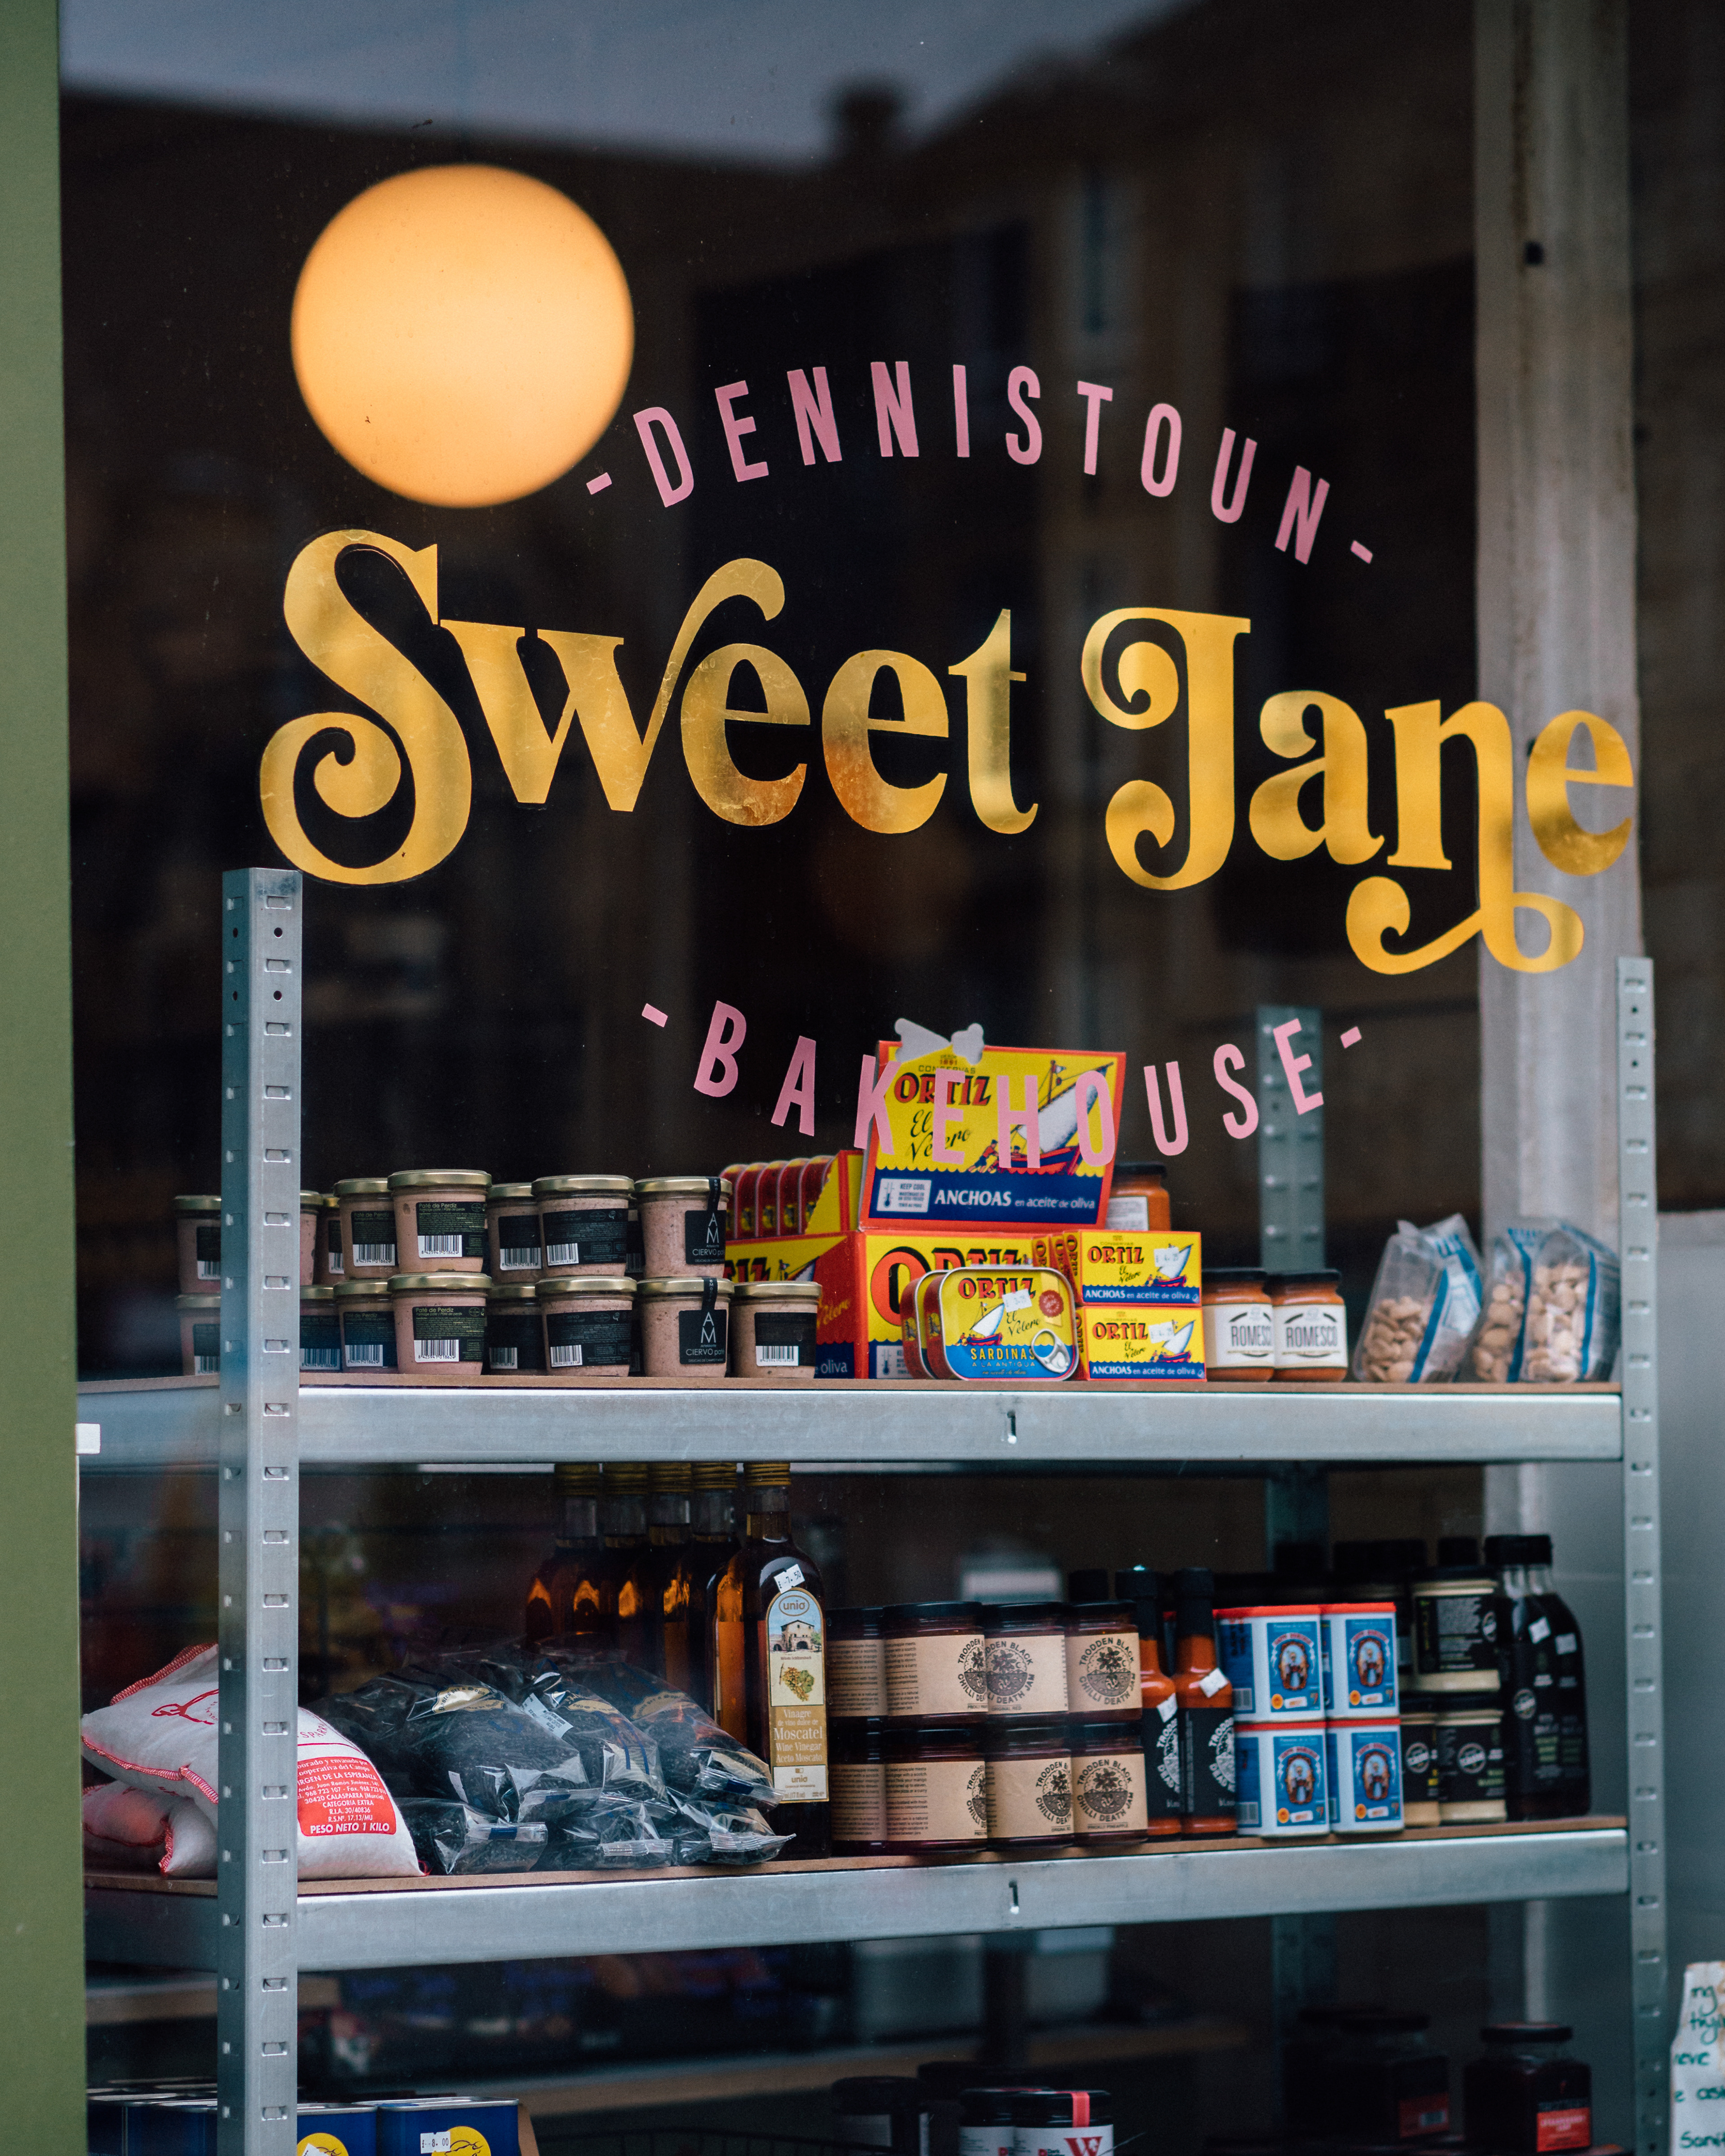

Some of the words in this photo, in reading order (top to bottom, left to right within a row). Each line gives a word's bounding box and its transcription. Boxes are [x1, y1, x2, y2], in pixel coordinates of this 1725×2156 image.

[259, 528, 1039, 885] Sweet
[1082, 606, 1634, 973] Jane
[934, 1190, 1011, 1206] ANCHOAS
[1026, 1197, 1057, 1208] aceite
[1058, 1200, 1069, 1208] de
[1070, 1197, 1095, 1209] oliva
[1087, 1246, 1145, 1264] ORTIZ
[958, 1277, 1036, 1299] ORTIZ
[1085, 1290, 1125, 1299] ANCHOAS
[1092, 1322, 1149, 1340] ORTIZ
[1231, 1325, 1272, 1347] ROMESC
[1286, 1325, 1338, 1348] ROMESCO
[970, 1348, 1035, 1360] SARDINAS
[820, 1359, 848, 1374] oliva
[1092, 1366, 1132, 1374] ANCHOAS
[1010, 1642, 1034, 1666] BLACK
[1079, 1637, 1114, 1666] TRODDEN
[1116, 1639, 1134, 1662] BLACK
[957, 1673, 975, 1698] CHILLI
[1079, 1675, 1101, 1702] CHILLI
[1104, 1691, 1130, 1705] DEATH
[996, 1691, 1026, 1705] DEATH
[783, 1709, 812, 1720] Vinagre
[774, 1726, 823, 1741] Moscatel
[775, 1742, 793, 1752] Wine
[795, 1742, 822, 1753] Vinegar
[776, 1754, 794, 1763] Aceto
[795, 1753, 823, 1763] Moscato
[297, 1765, 338, 1778] ooperativa
[349, 1764, 370, 1773] Campo
[297, 1776, 322, 1786] IRGEN
[345, 1771, 378, 1781] ESPERANZA
[1036, 1761, 1063, 1788] TRODDEN
[1077, 1759, 1110, 1786] TRODDEN
[1112, 1760, 1133, 1783] BLACK
[304, 1795, 325, 1805] 30420
[326, 1792, 364, 1801] CALASPARRA
[322, 1800, 356, 1808] CATEGORIA
[1035, 1797, 1055, 1822] CHILLI
[1077, 1794, 1097, 1820] CHILLI
[1099, 1809, 1127, 1822] DEATH
[310, 1824, 333, 1834] PESO
[336, 1823, 359, 1832] NETO
[362, 1822, 367, 1831] 1
[369, 1822, 390, 1832] KILO
